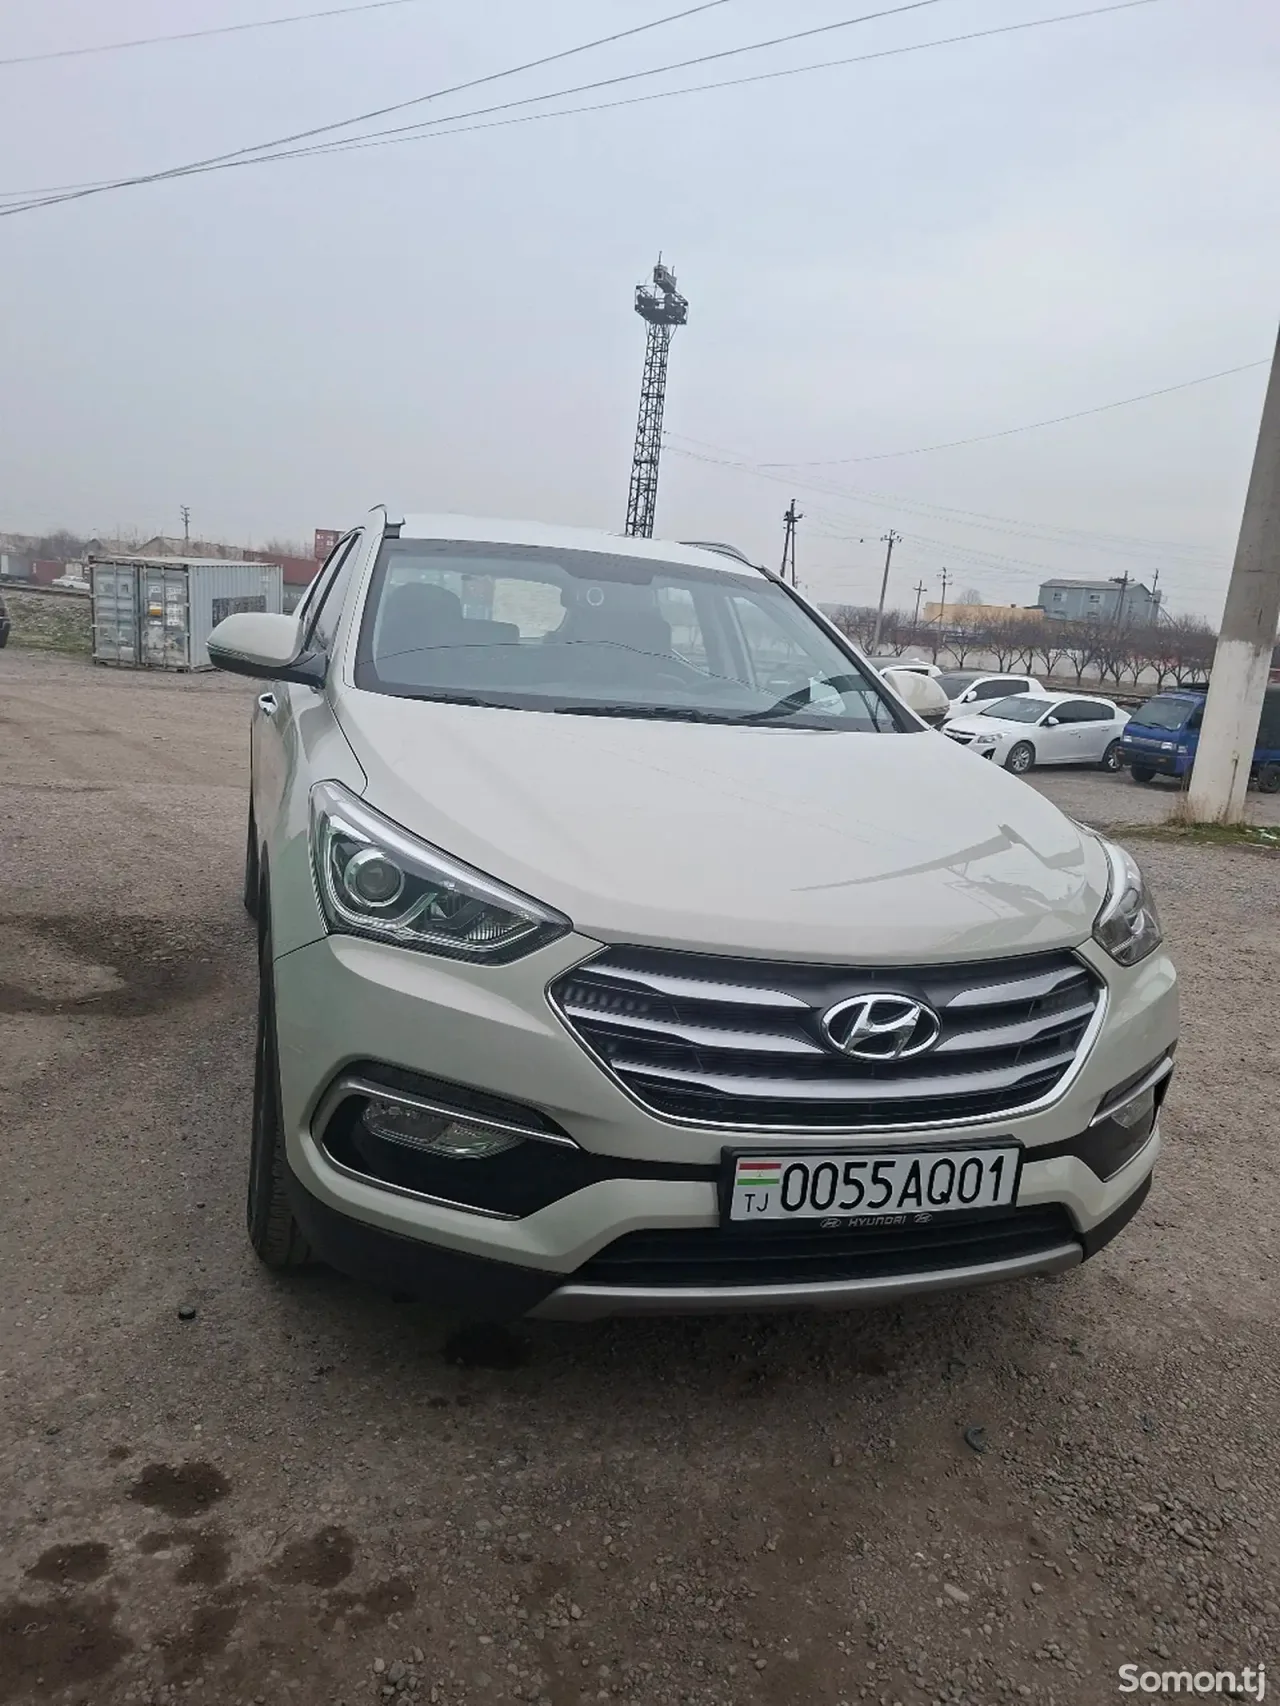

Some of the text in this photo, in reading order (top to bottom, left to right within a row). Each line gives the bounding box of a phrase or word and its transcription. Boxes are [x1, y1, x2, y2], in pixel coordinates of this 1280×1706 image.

[780, 1155, 1005, 1212] 0055AQ01
[744, 1193, 769, 1213] TJ
[848, 1215, 907, 1227] HYUNDAI
